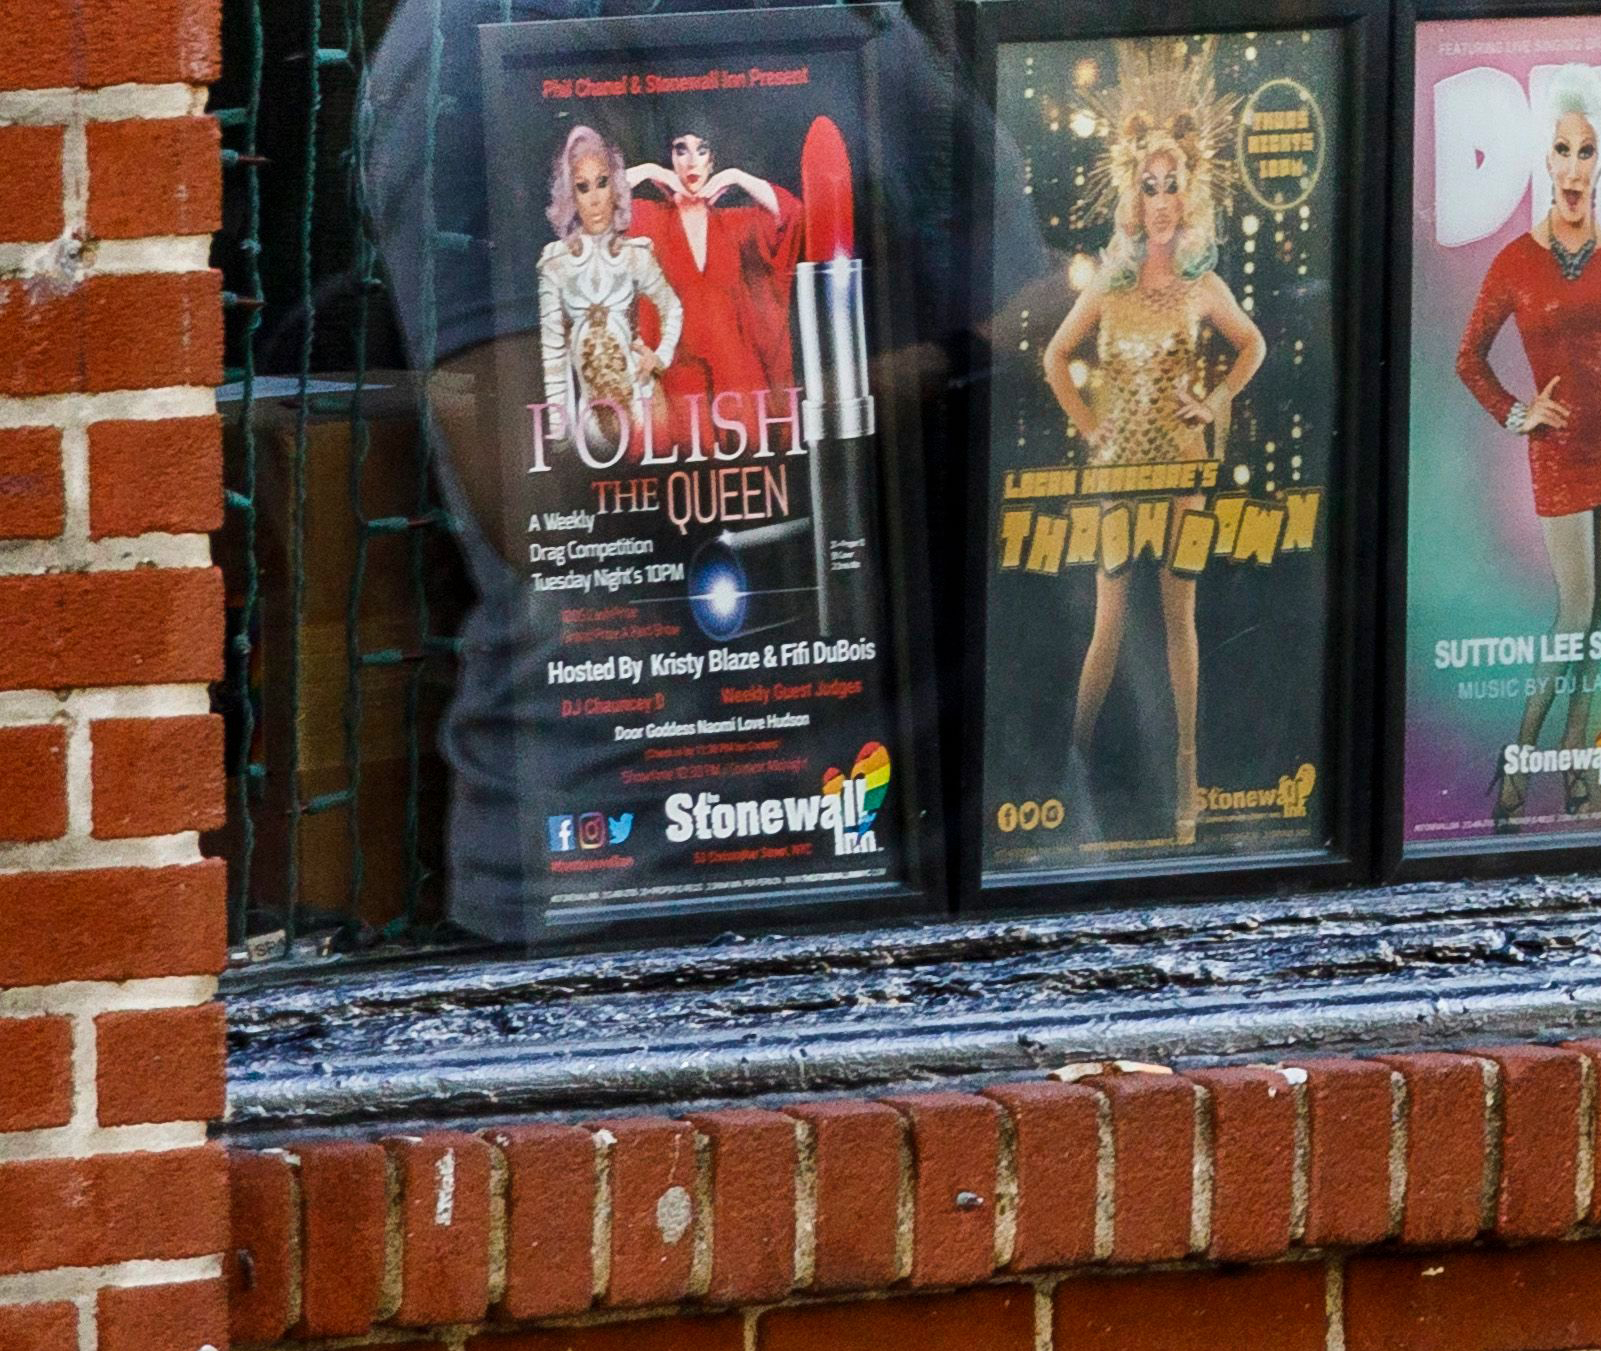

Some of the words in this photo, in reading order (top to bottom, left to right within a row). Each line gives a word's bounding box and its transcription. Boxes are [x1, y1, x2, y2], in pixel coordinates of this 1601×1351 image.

[647, 73, 718, 94] Stonewall
[721, 73, 747, 90] Inn
[750, 68, 809, 88] Present
[526, 387, 807, 473] POLISH
[592, 479, 659, 517] THE
[667, 465, 789, 534] QUEEN
[529, 515, 541, 532] A
[543, 511, 595, 533] Weekly
[999, 487, 1326, 576] THROWDOWN
[530, 542, 565, 563] Drag
[567, 537, 654, 561] Competition
[531, 569, 592, 593] Tuesday
[594, 566, 643, 592] Night's
[646, 563, 684, 584] 10PM
[547, 656, 615, 684] Hosted
[618, 656, 642, 683] By
[651, 652, 704, 679] Kristy
[709, 646, 760, 672] Blaze
[763, 644, 778, 668] &
[781, 641, 809, 667] Fifi
[813, 637, 876, 665] DuBois
[1434, 636, 1534, 669] SUTTON
[1540, 632, 1584, 663] LEE
[721, 686, 769, 707] Weekly
[774, 683, 812, 701] Guest
[816, 678, 862, 700] Judges
[1458, 677, 1519, 700] MUSIC
[1525, 677, 1549, 697] BY
[1554, 675, 1576, 695] DJ
[615, 724, 643, 742] Door
[646, 720, 695, 739] Goddess
[697, 717, 736, 735] Naomi
[738, 716, 765, 733] Love
[767, 712, 810, 731] Hudson
[666, 777, 866, 843] Stonewall
